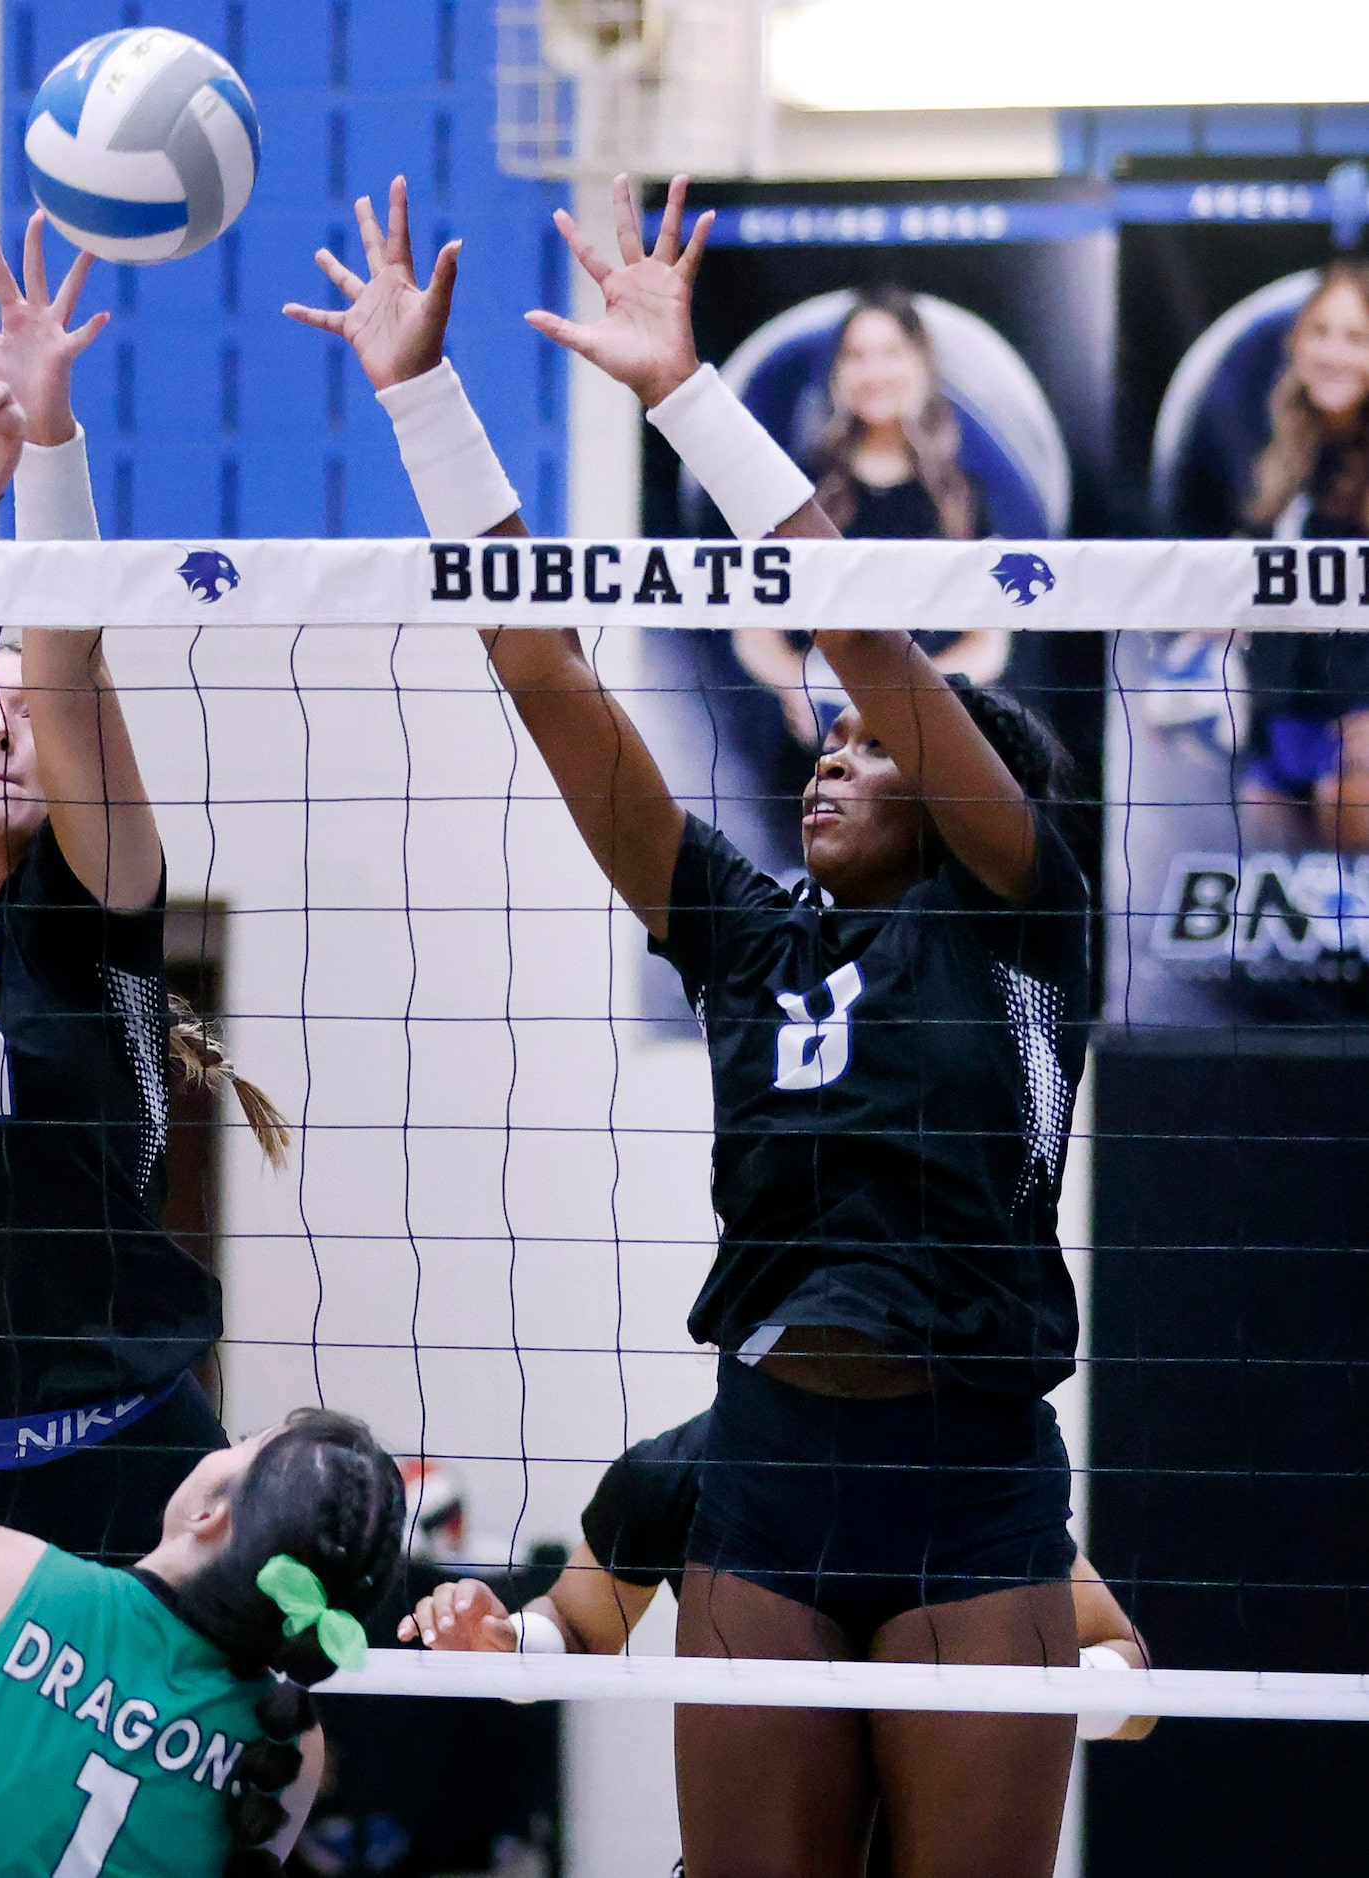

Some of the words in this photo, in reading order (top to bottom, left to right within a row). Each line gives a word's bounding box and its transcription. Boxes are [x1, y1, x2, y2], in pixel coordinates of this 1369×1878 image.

[429, 543, 791, 605] BOBCATS
[1252, 545, 1369, 606] BO
[51, 1750, 141, 1878] 1
